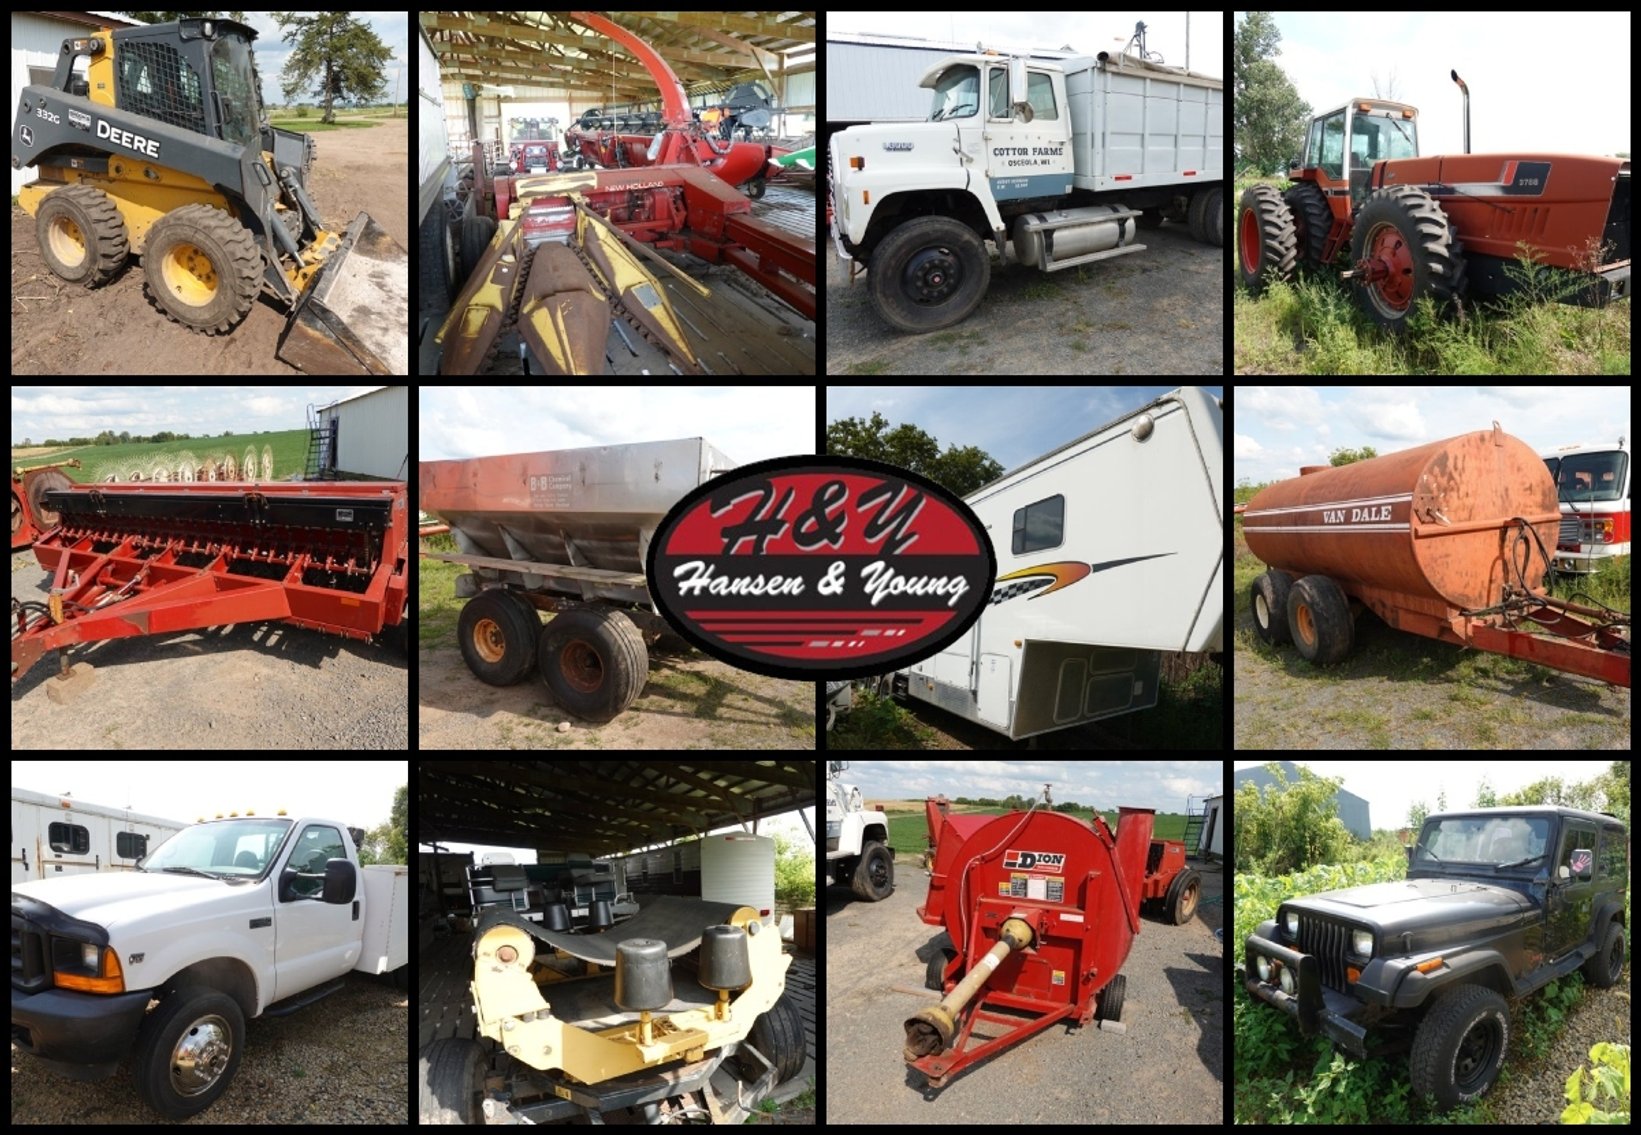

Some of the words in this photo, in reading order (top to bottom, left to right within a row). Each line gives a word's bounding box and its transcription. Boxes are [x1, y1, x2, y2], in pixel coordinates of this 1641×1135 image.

[36, 108, 60, 125] 332G
[97, 119, 160, 158] DEERE
[1323, 510, 1346, 524] VAN
[1351, 505, 1392, 522] DALE
[1017, 852, 1063, 869] DION
